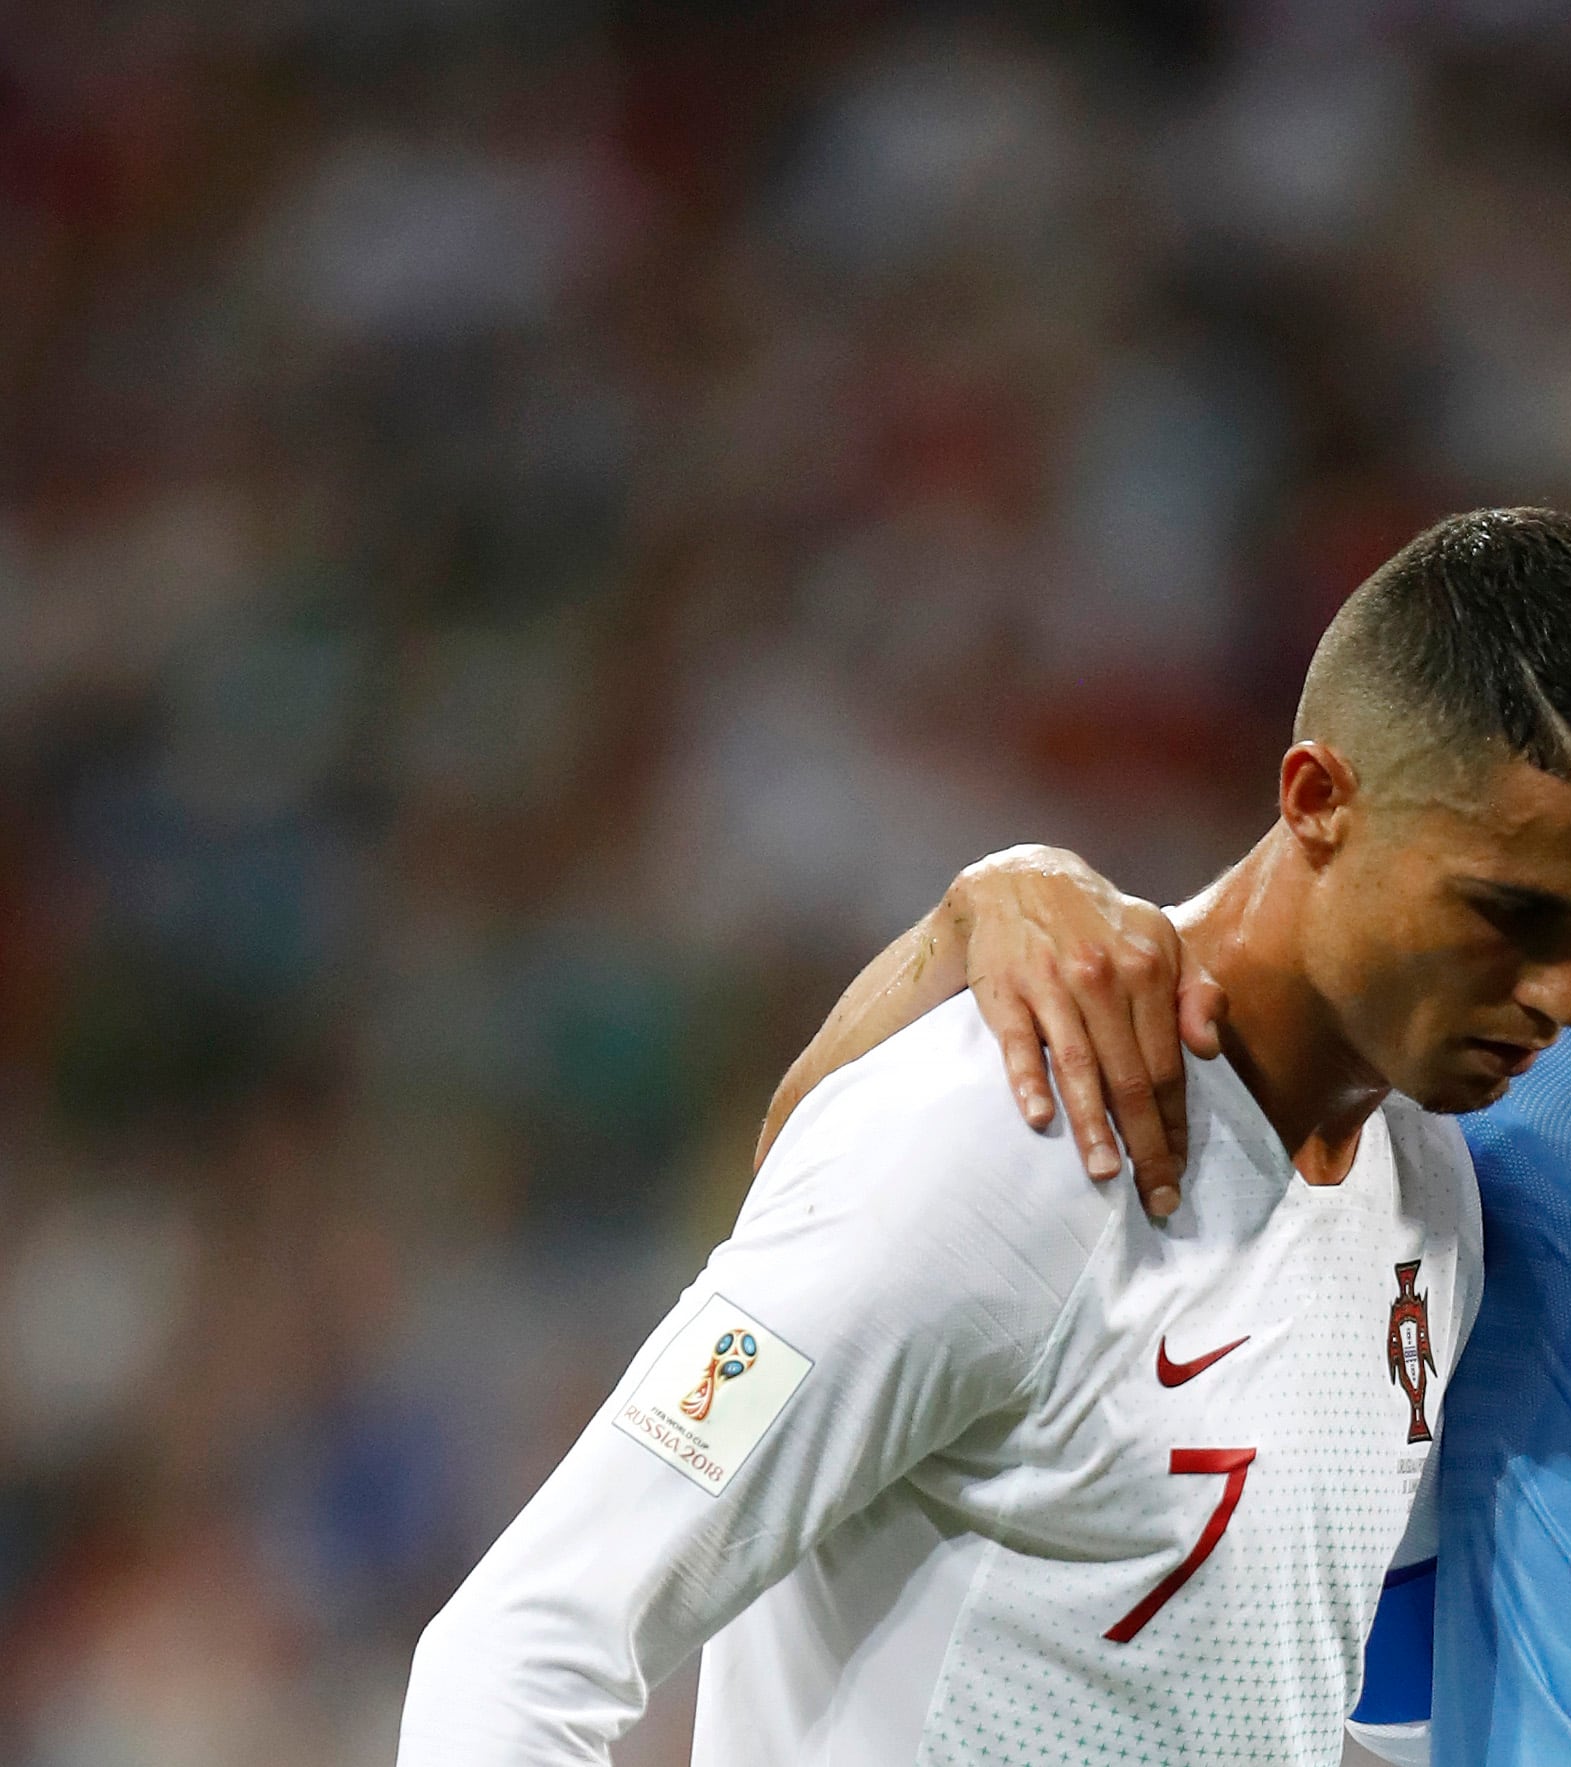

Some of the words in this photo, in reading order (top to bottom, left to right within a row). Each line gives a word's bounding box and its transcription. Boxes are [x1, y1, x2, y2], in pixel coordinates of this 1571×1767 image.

[623, 1404, 680, 1453] RUSSIA
[680, 1445, 724, 1482] 2018
[651, 1407, 667, 1421] FIFA
[666, 1416, 693, 1439] WORLD
[692, 1437, 710, 1449] CUP
[1102, 1447, 1257, 1643] 7
